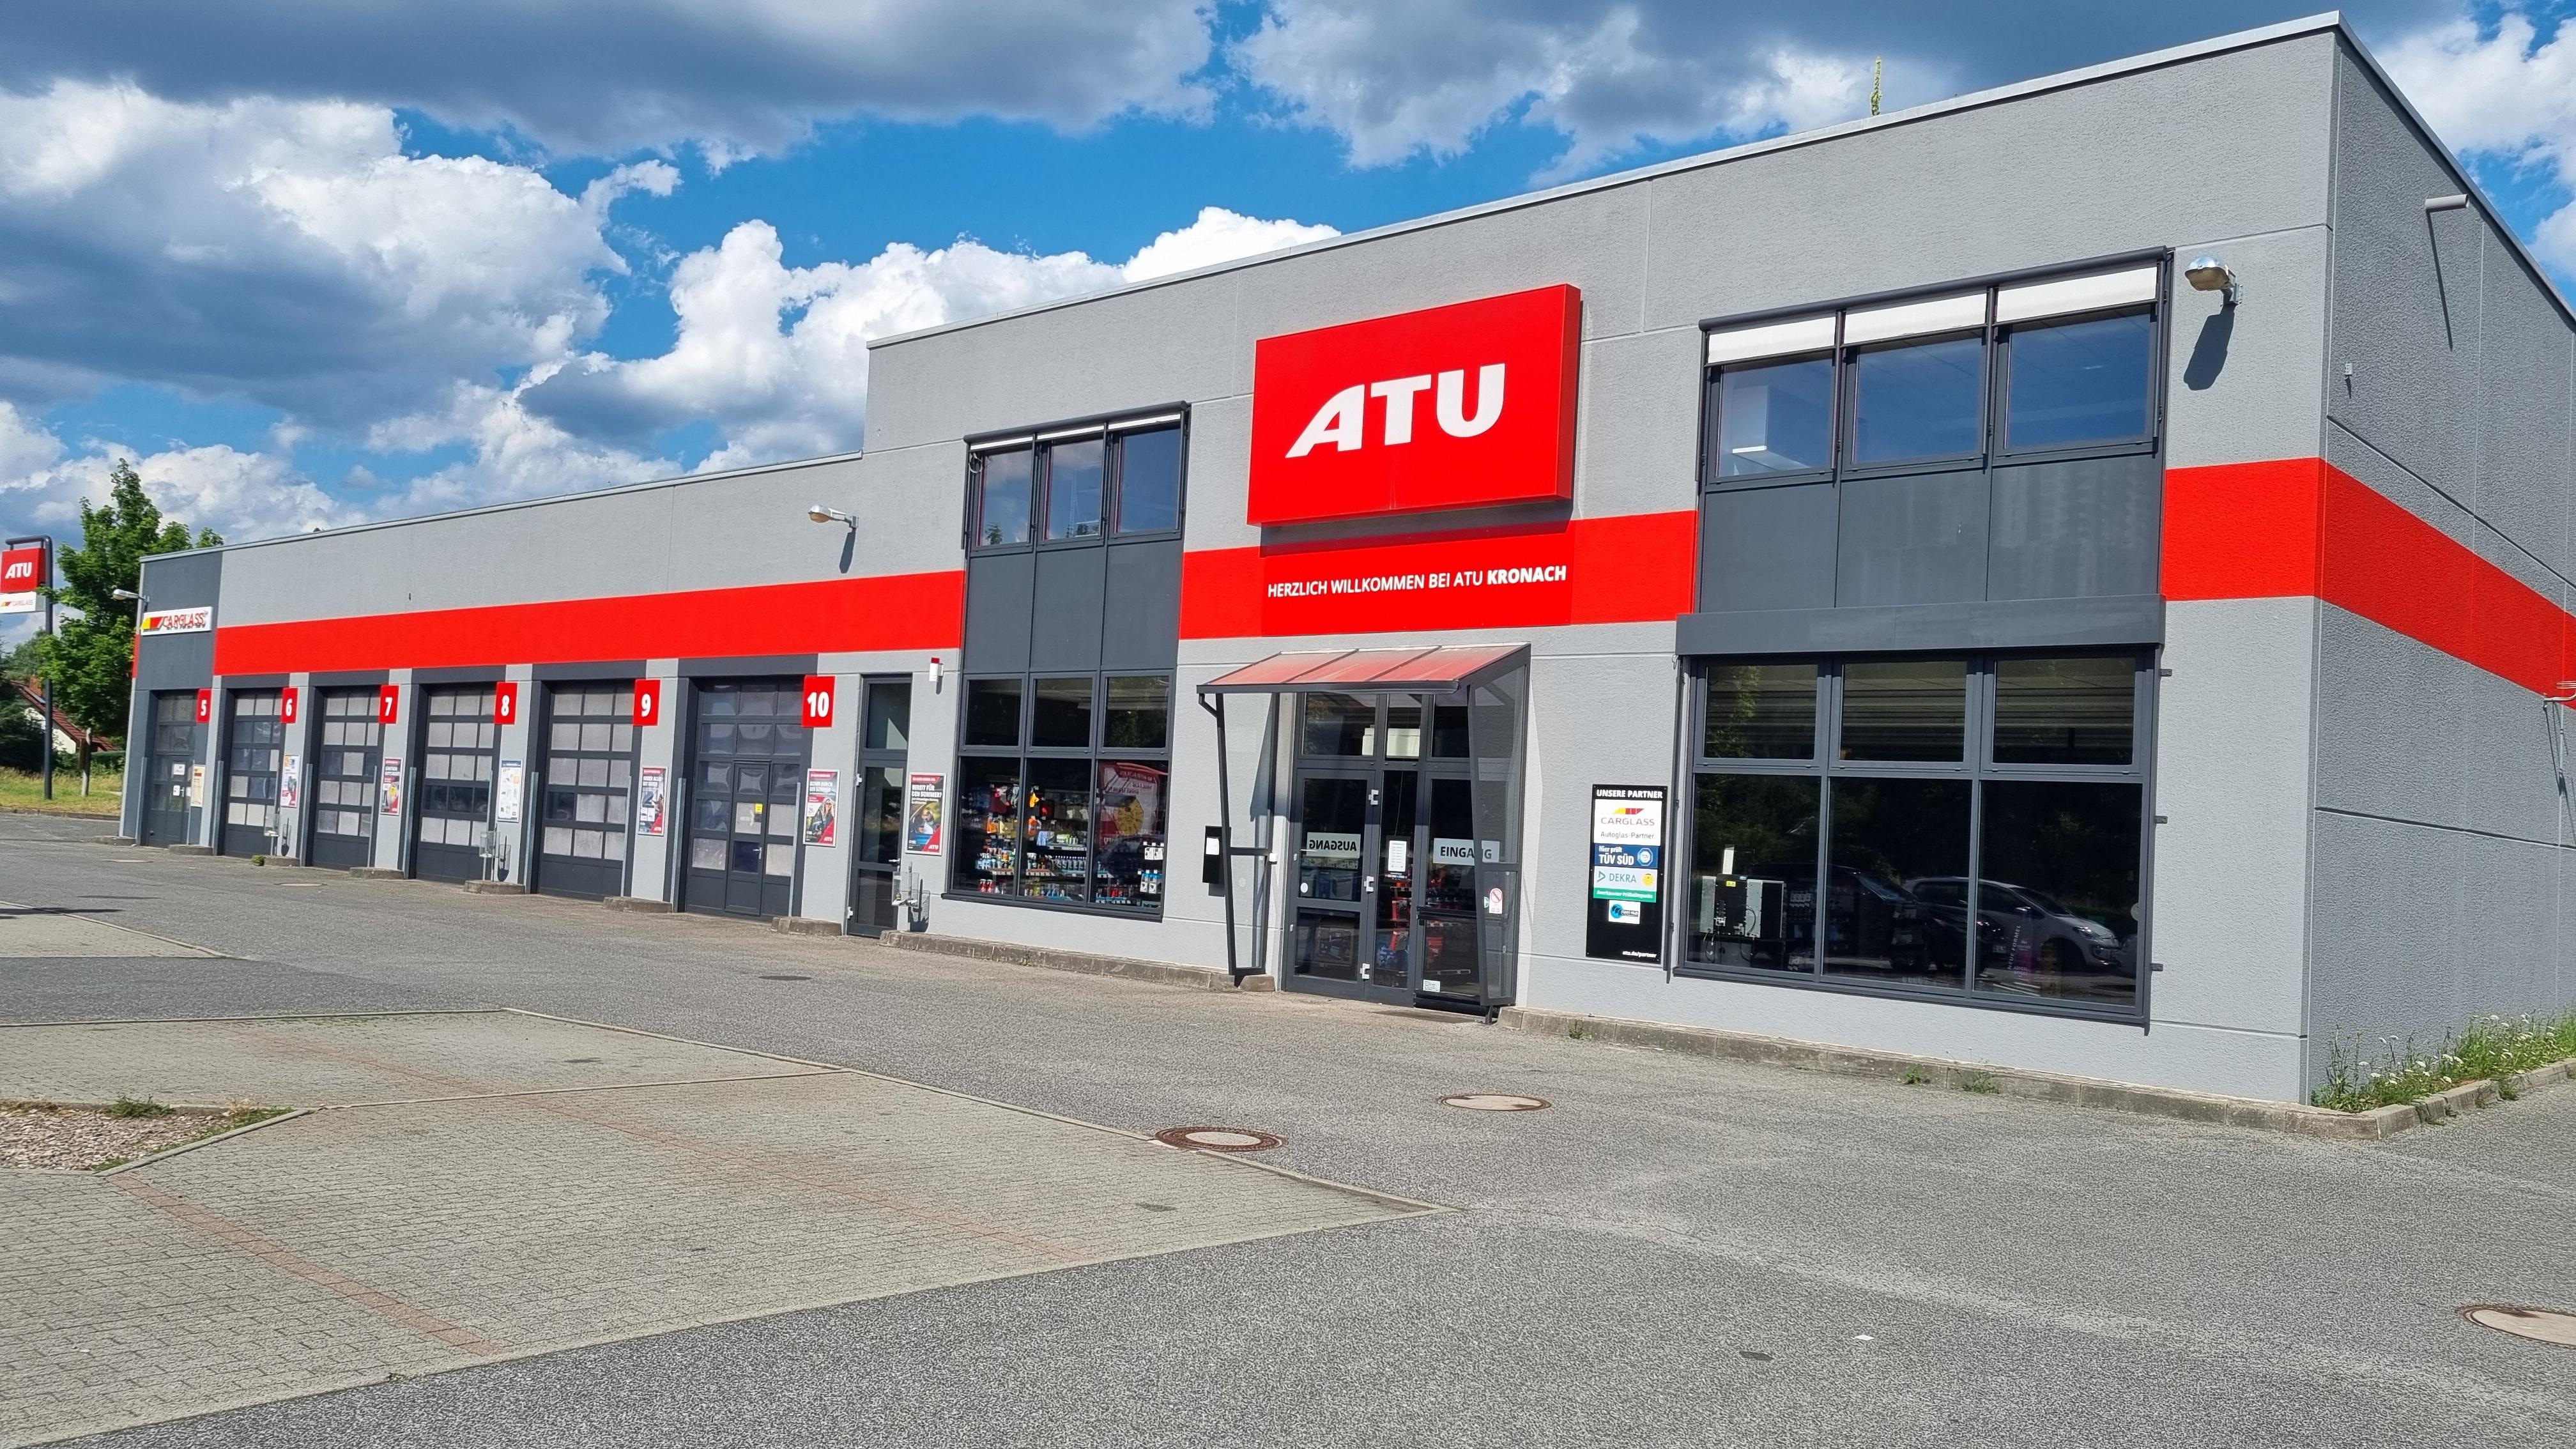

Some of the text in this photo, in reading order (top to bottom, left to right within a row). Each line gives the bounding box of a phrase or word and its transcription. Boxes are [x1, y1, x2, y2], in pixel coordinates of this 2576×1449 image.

[1285, 363, 1505, 458] ATU
[5, 562, 33, 579] ATU
[1268, 565, 1567, 597] HERZLICH WILLKOMMEN BEI ATU KRONACH
[162, 612, 205, 628] CARGLASS
[200, 700, 207, 716] 5
[286, 698, 292, 716] 6
[385, 697, 393, 716] 7
[501, 694, 510, 716] 8
[641, 693, 651, 717] 9
[807, 691, 829, 717] 10
[1597, 789, 1663, 799] UNSERE PARTNER
[1600, 817, 1655, 826] CARGLASS
[1440, 846, 1492, 859] EINGAG
[1598, 852, 1634, 865] TÜV SÜD
[1609, 873, 1637, 883] DEKRA
[2011, 924, 2021, 951] FORMEL
